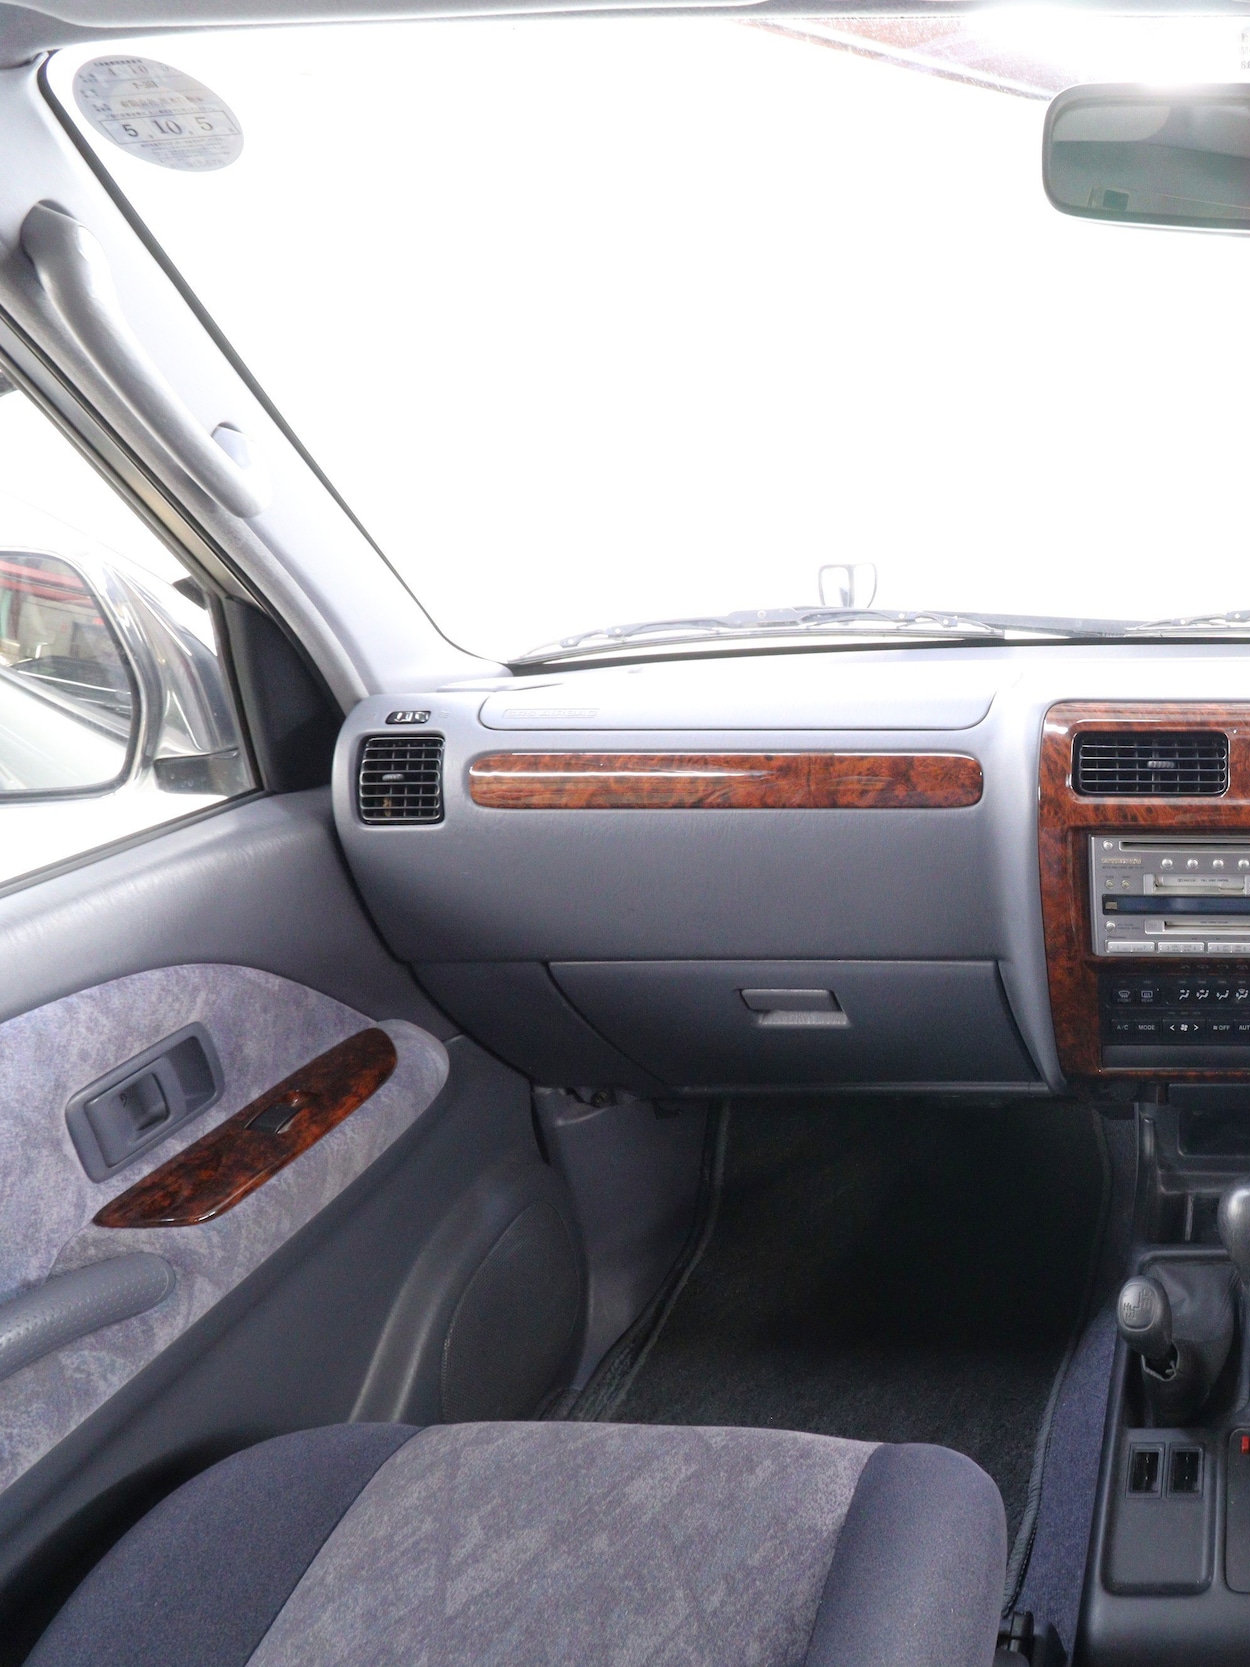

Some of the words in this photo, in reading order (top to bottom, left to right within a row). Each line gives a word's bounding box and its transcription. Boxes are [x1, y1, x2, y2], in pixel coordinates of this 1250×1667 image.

[122, 123, 139, 138] 5
[152, 119, 183, 135] 10
[195, 117, 214, 131] 5
